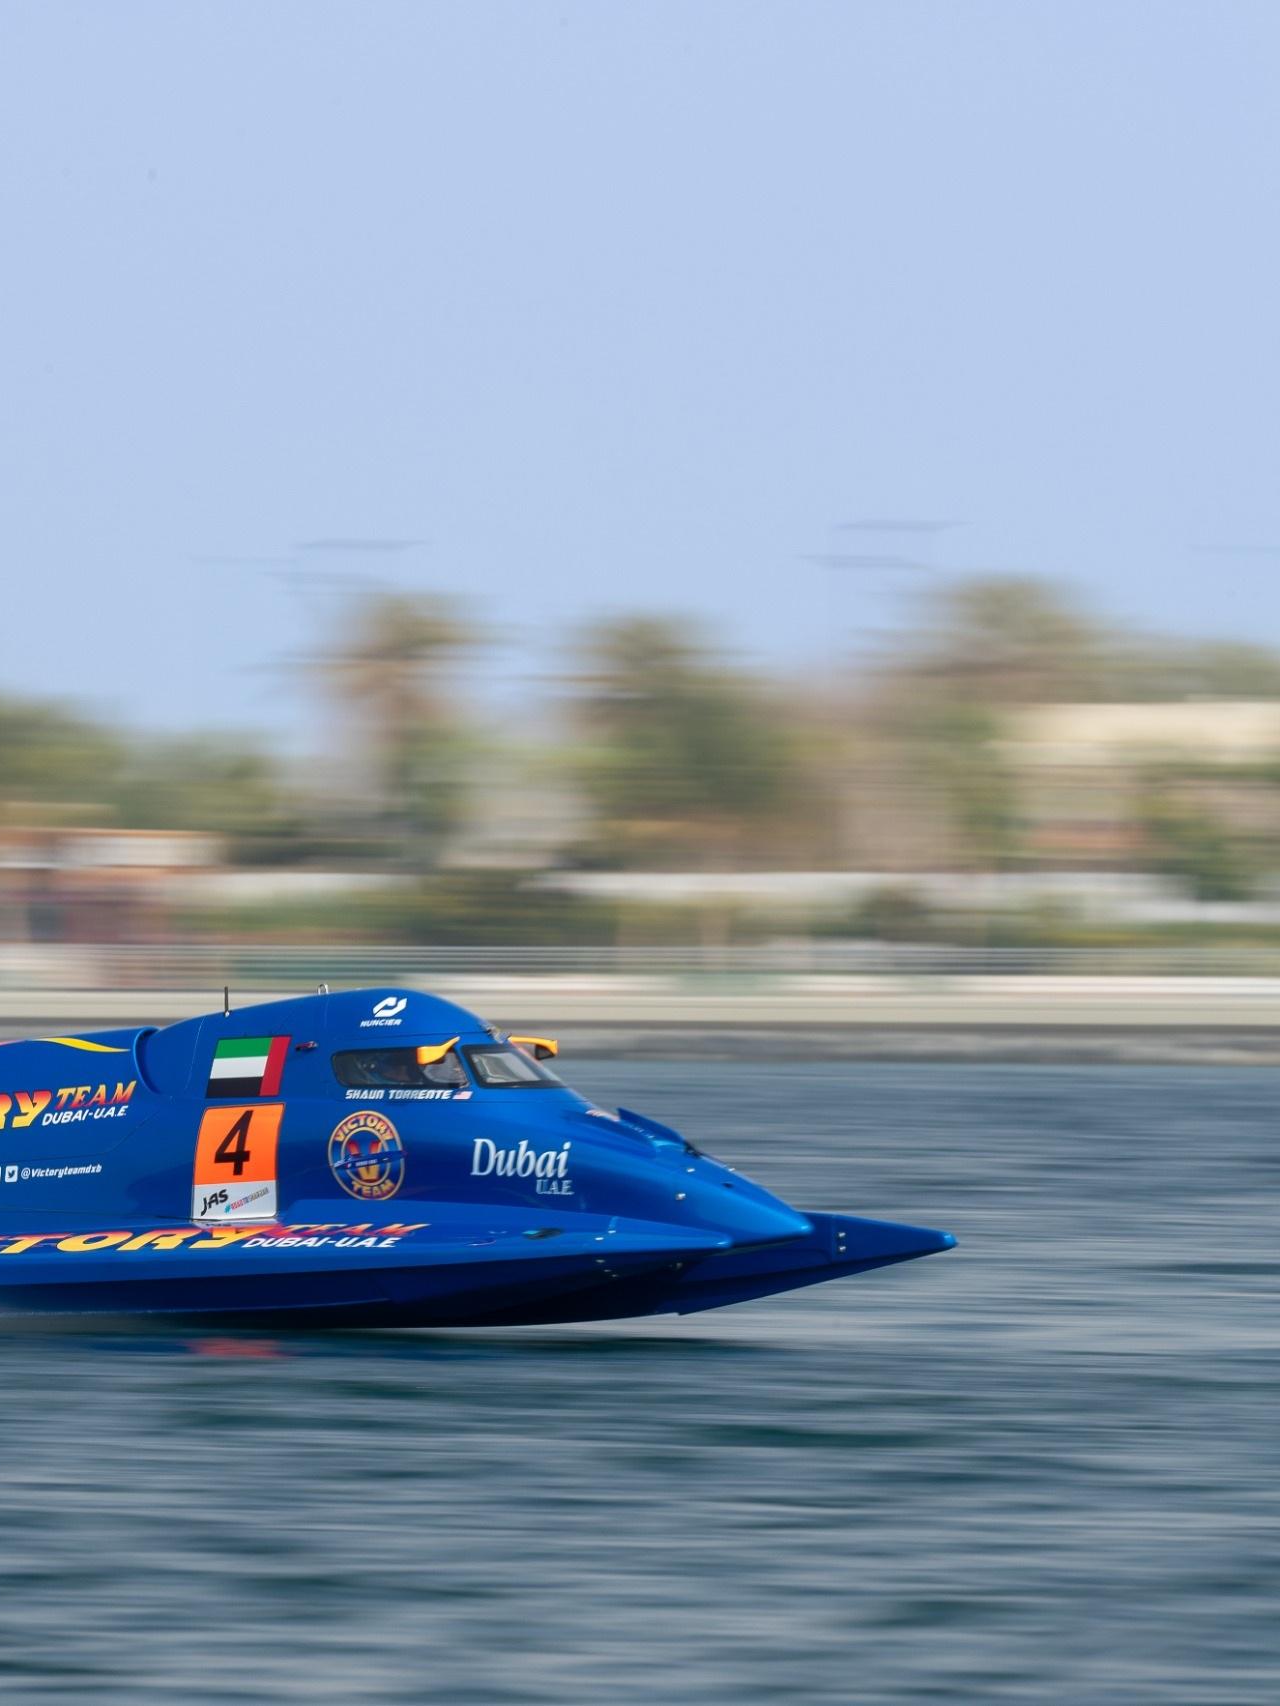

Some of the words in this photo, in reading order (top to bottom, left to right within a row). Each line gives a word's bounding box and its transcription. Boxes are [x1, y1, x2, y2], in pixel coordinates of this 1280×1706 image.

[54, 1080, 137, 1110] TEAM
[345, 1089, 385, 1100] SHAUN
[388, 1089, 454, 1100] TORRENTE
[333, 1114, 396, 1142] VICTORY
[214, 1109, 254, 1176] 4
[20, 1163, 102, 1180] @Victoryteamdxb
[470, 1138, 572, 1178] Dubai
[200, 1188, 230, 1217] JAS
[276, 1223, 432, 1237] TEAM
